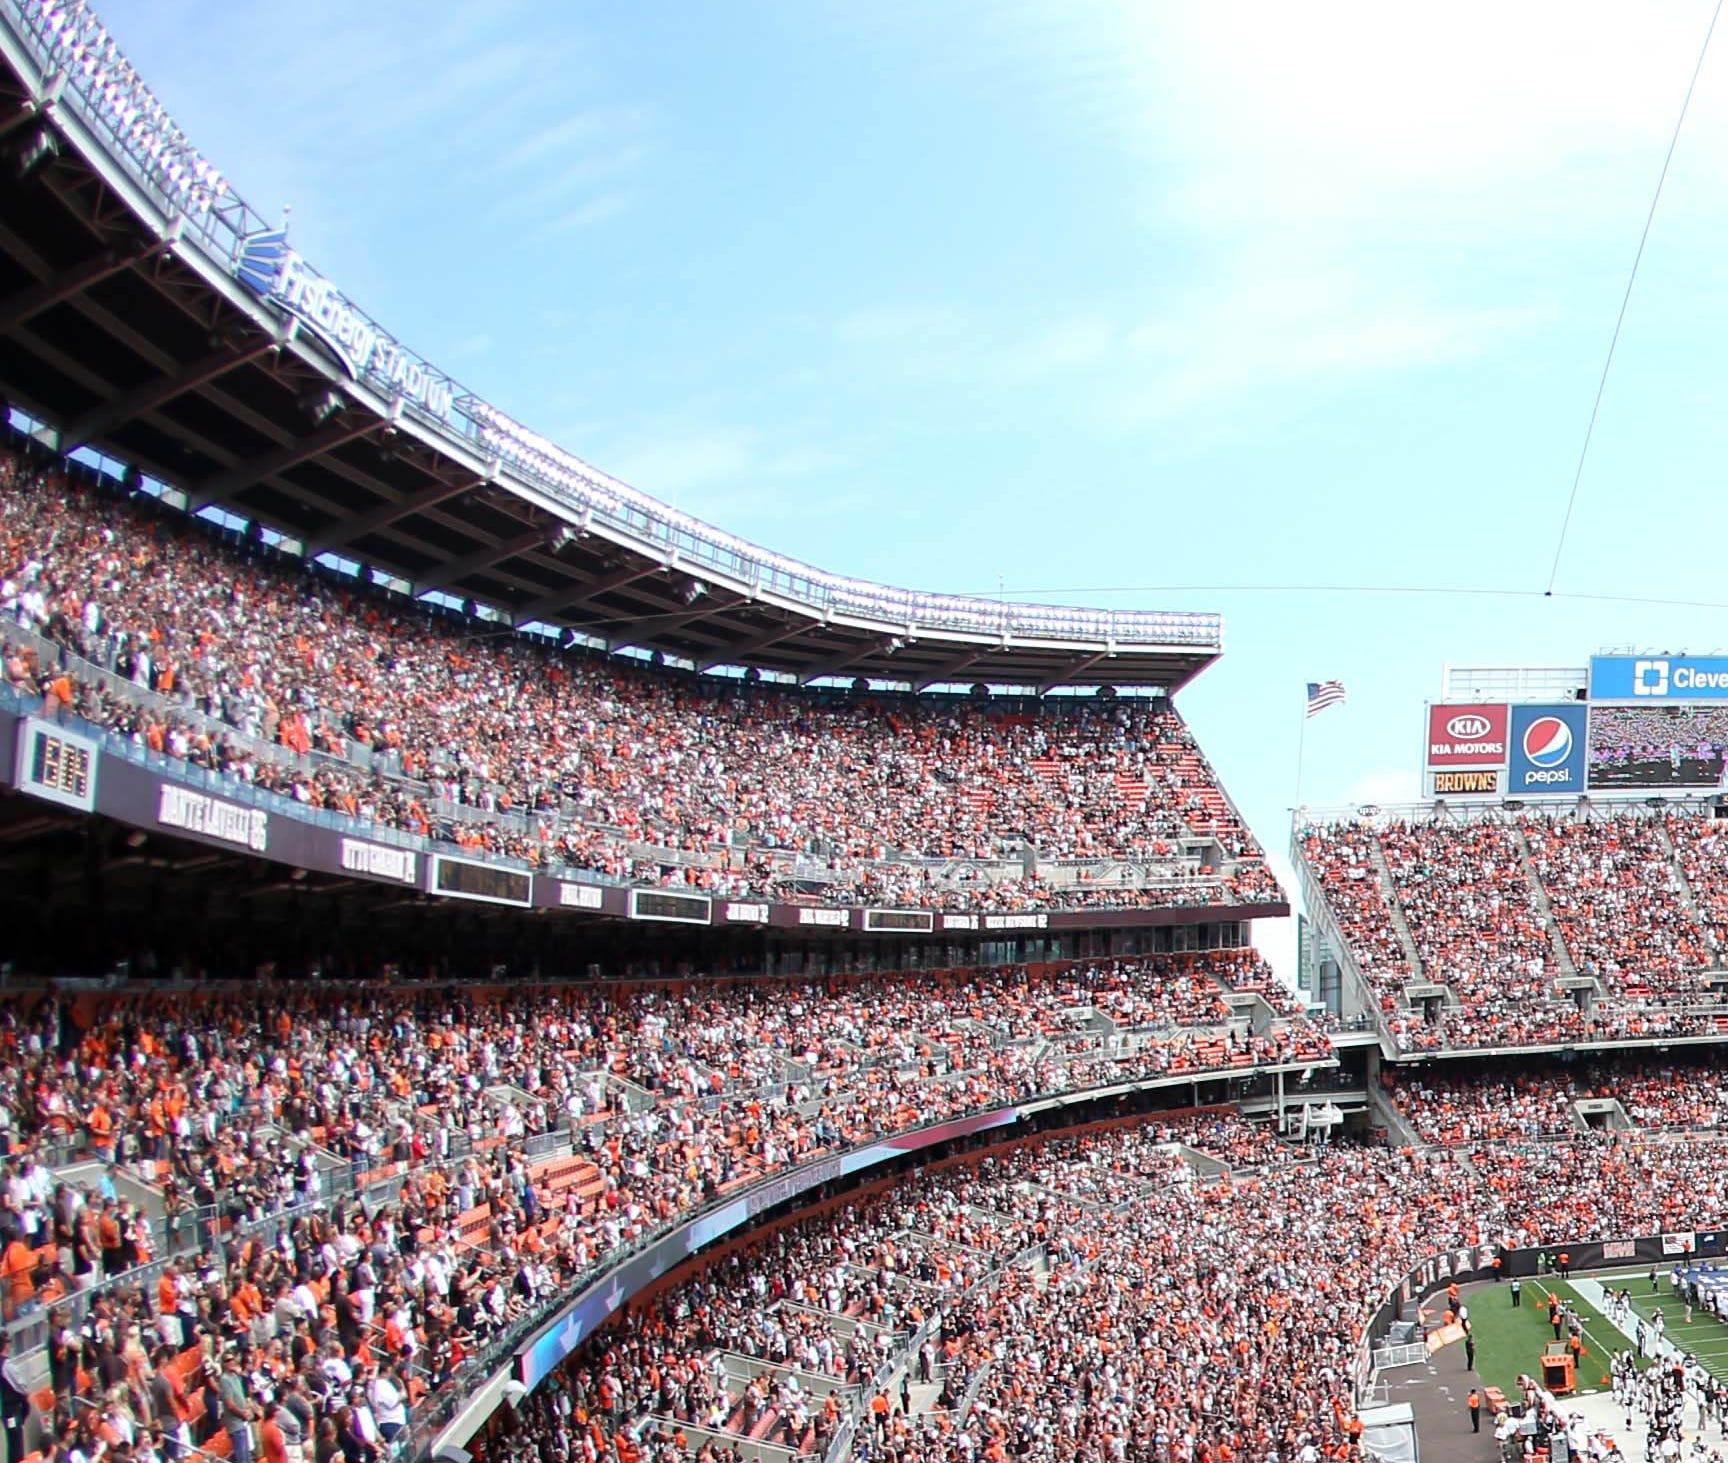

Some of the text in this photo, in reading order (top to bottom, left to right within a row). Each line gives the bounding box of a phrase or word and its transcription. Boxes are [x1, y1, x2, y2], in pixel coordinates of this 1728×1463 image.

[373, 337, 452, 419] STADIUM
[1454, 719, 1483, 734] KIA
[1431, 742, 1503, 755] KIA MOTORS
[1435, 772, 1496, 792] BROWNS
